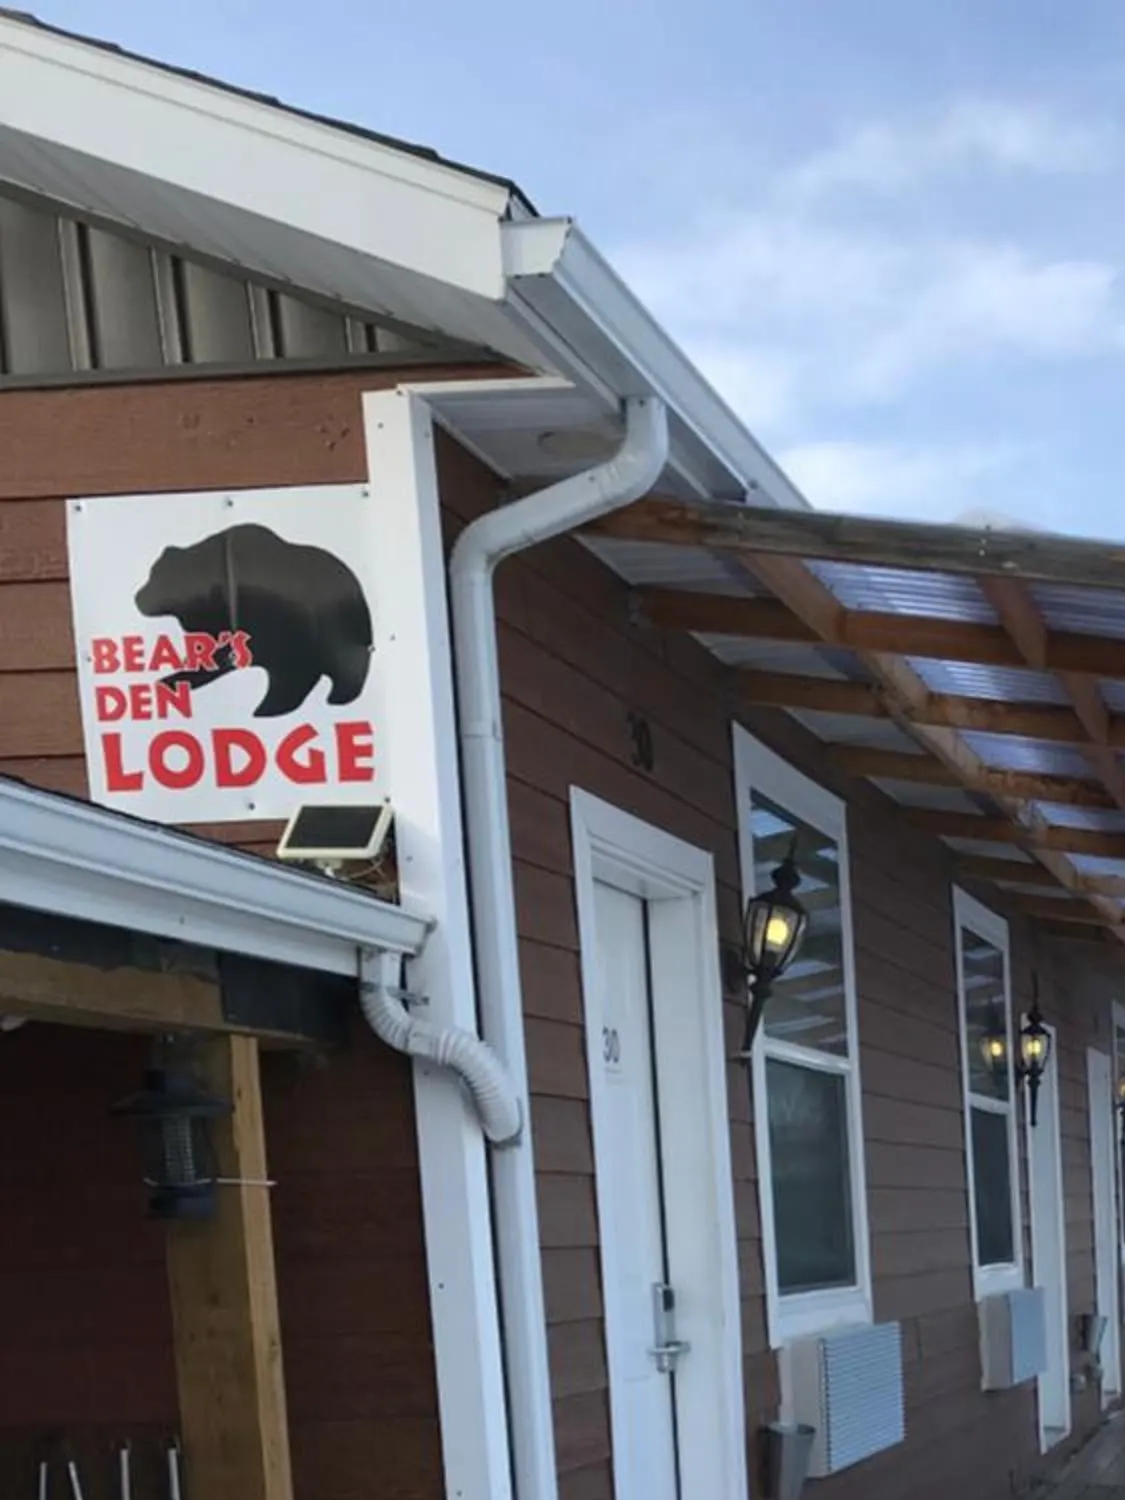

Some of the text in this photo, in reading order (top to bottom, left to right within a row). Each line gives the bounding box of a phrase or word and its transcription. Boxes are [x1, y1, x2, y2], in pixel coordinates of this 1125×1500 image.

[91, 630, 253, 674] BEAR'S
[95, 681, 194, 722] DEN
[101, 721, 376, 793] LODGE
[602, 1026, 621, 1064] 30
